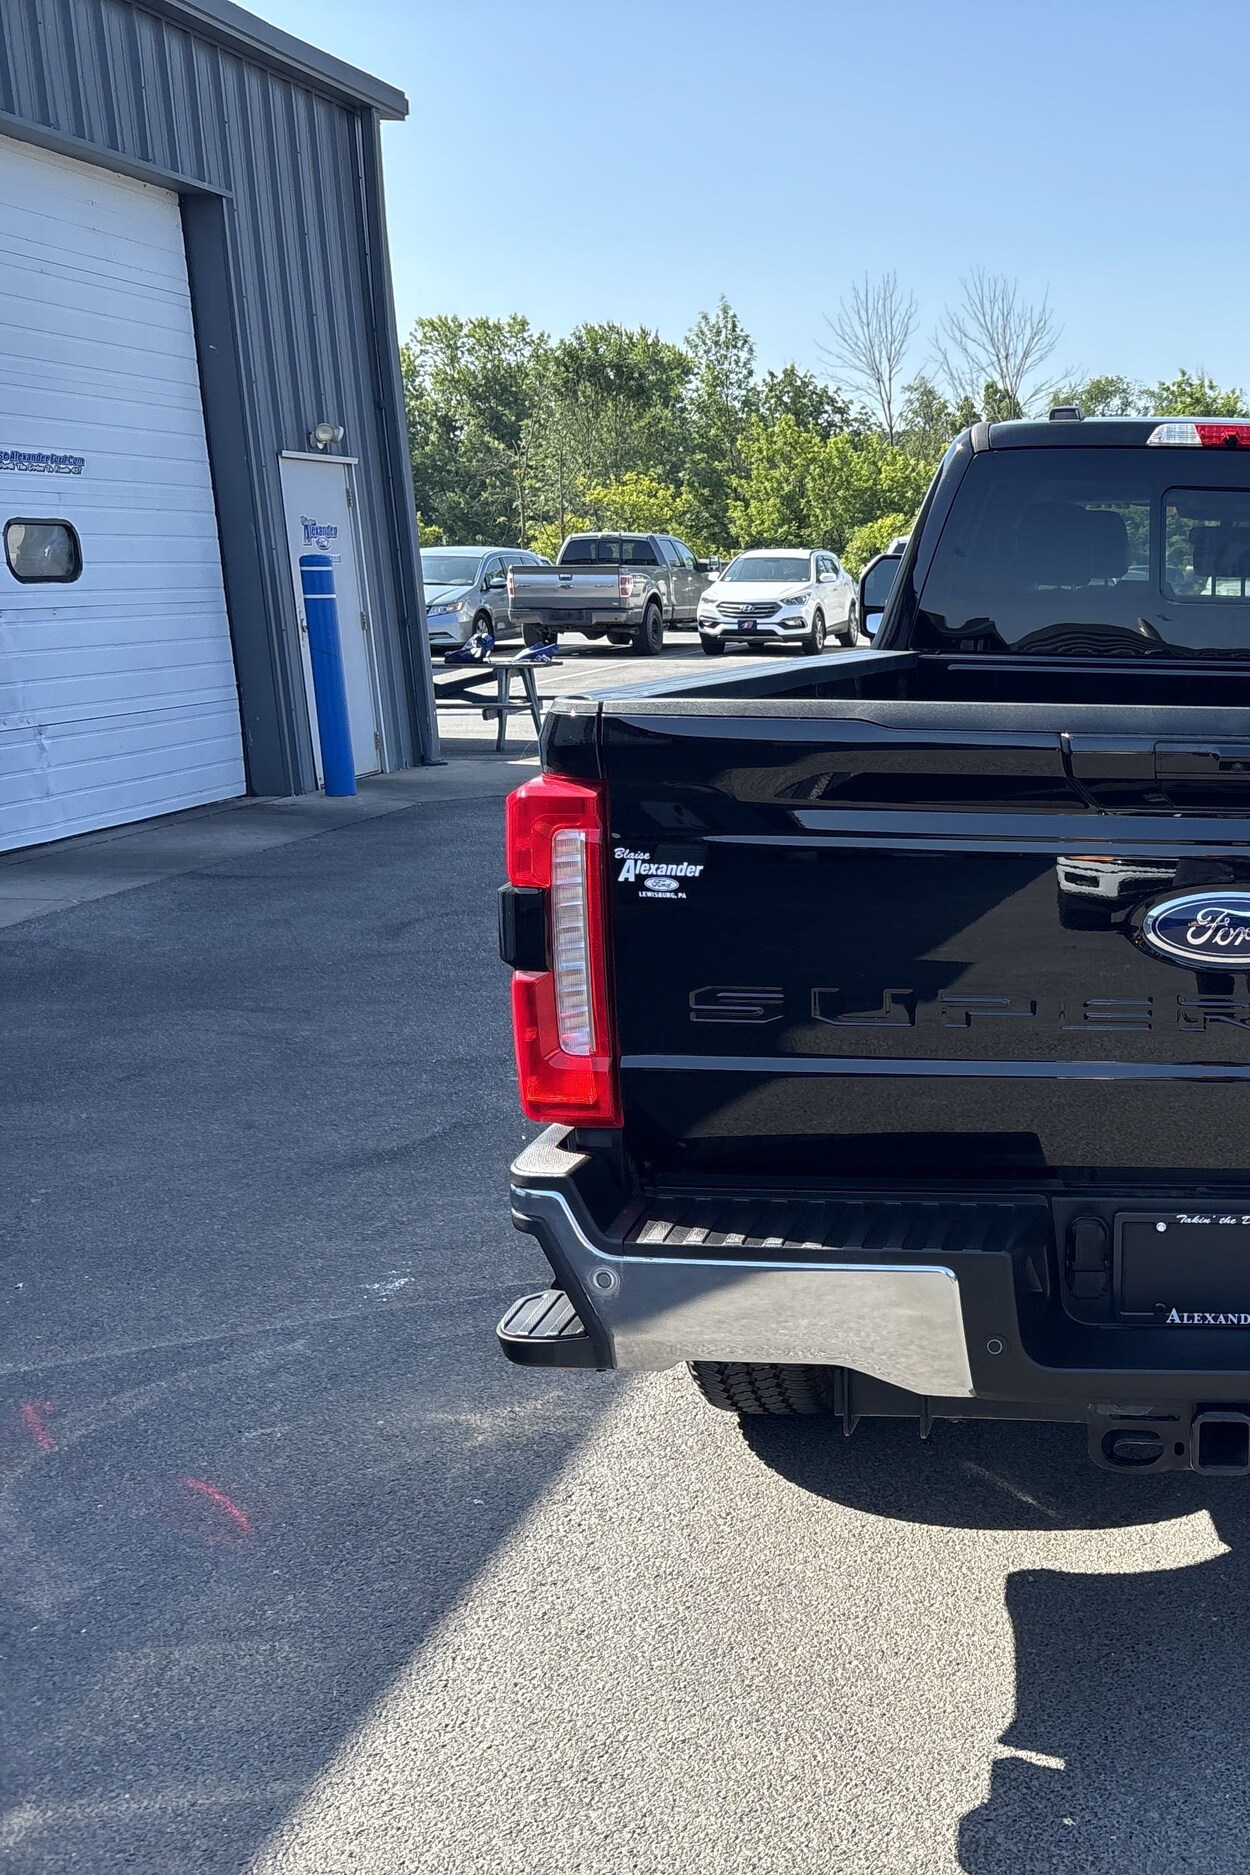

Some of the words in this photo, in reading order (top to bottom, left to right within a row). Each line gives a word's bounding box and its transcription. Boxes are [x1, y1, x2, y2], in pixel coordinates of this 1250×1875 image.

[614, 848, 650, 860] Blaise
[617, 859, 704, 882] Alexander
[638, 891, 678, 899] LEWISBURG,
[1176, 1214, 1216, 1224] Takin'
[1219, 1215, 1236, 1224] the
